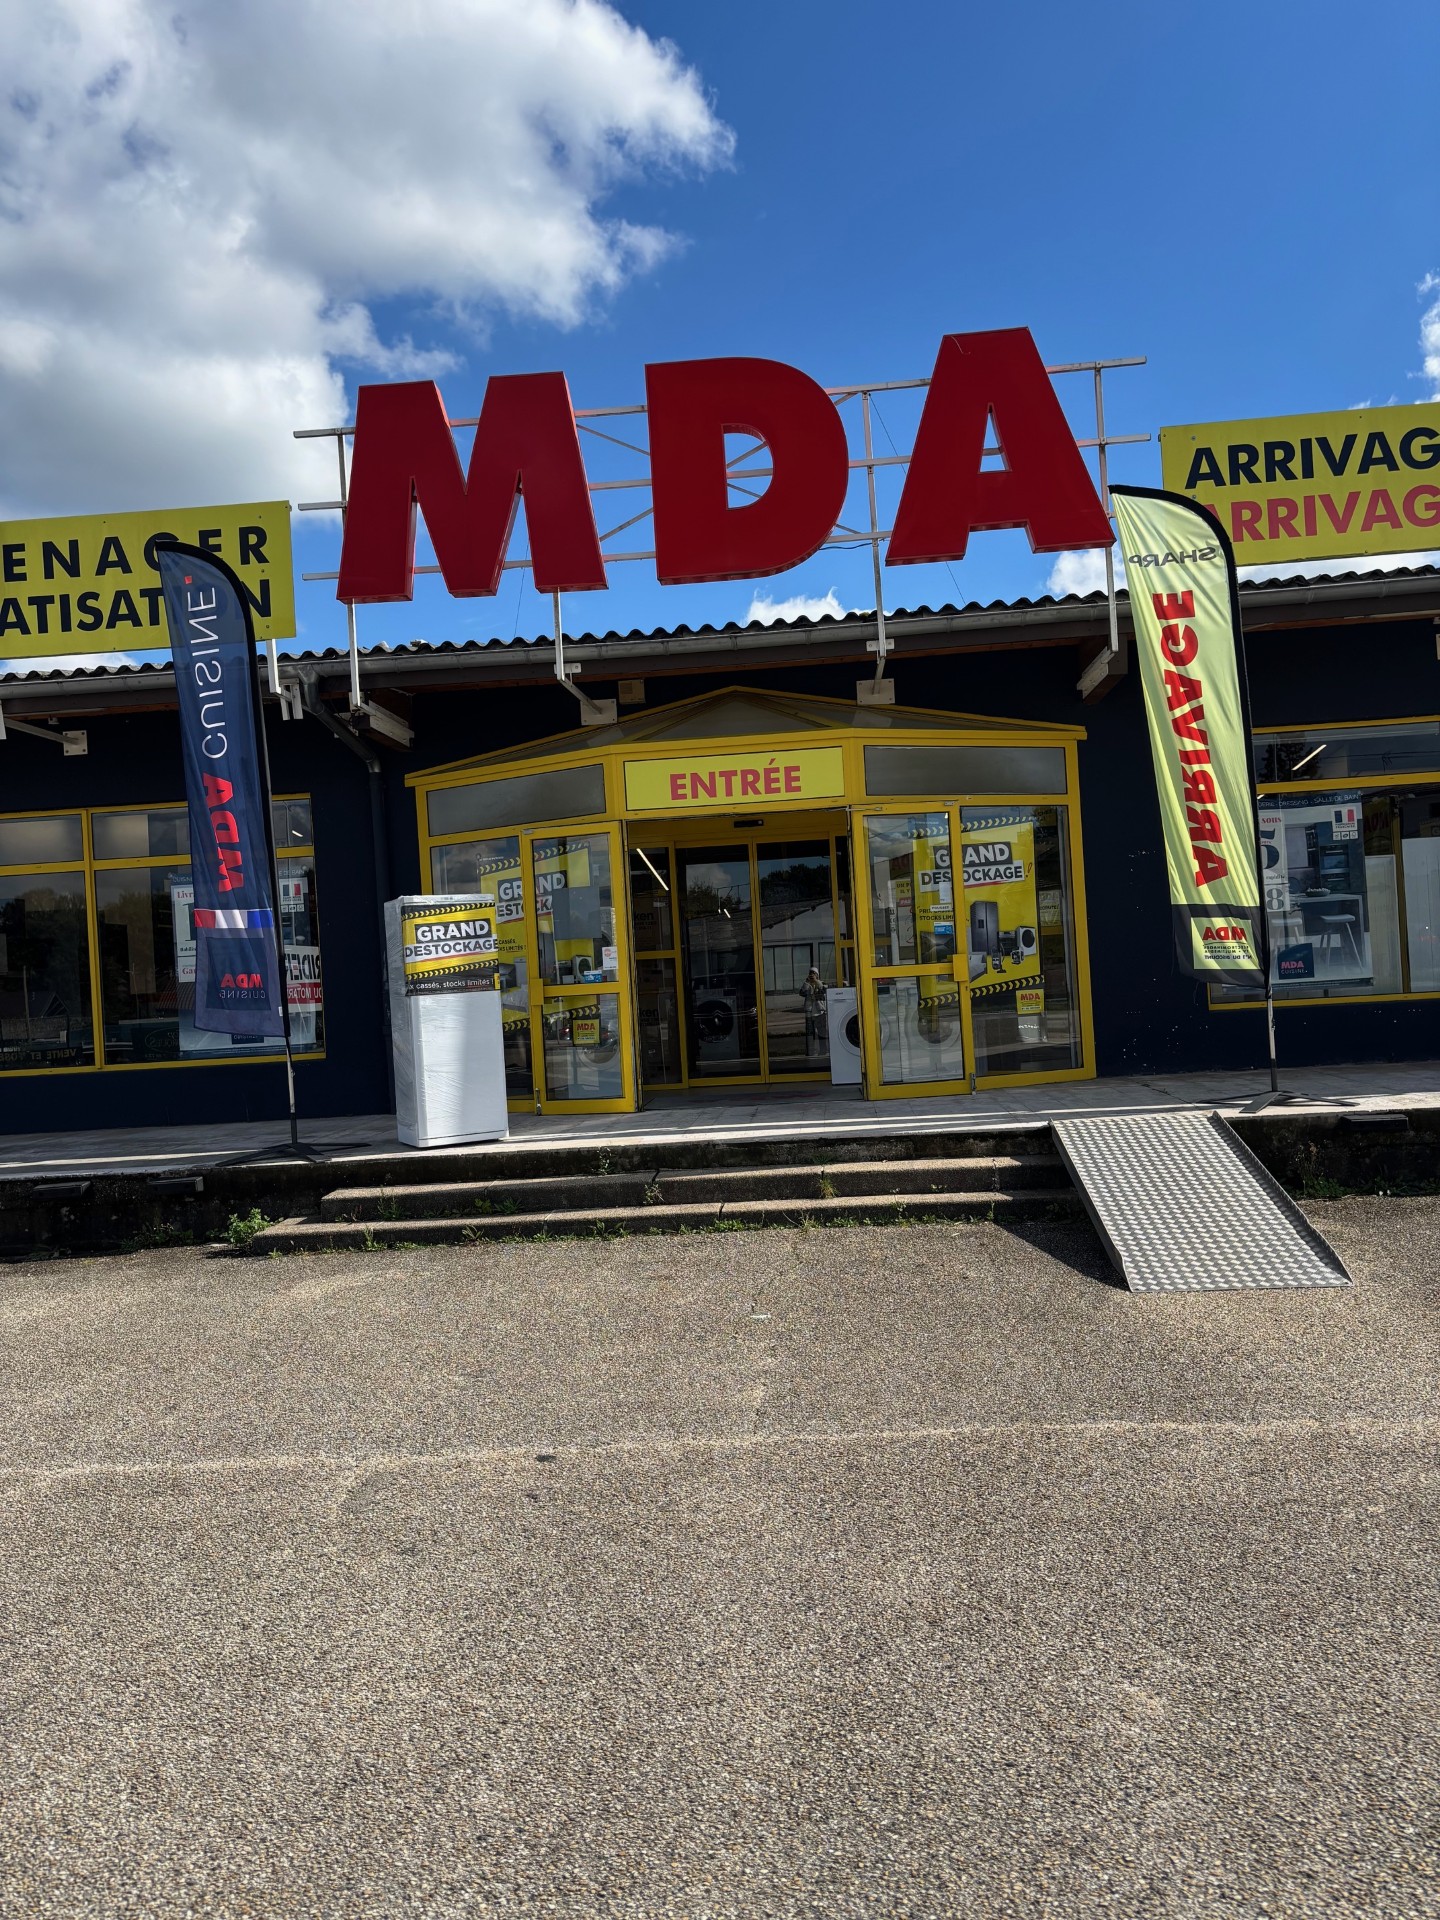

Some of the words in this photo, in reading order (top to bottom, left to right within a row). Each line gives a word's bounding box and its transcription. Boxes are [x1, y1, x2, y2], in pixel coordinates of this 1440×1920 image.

[338, 327, 1116, 603] MDA
[1185, 427, 1440, 489] ARRIVAG
[0, 578, 272, 637] ATISATN
[669, 758, 802, 801] ENTRÉE
[935, 844, 1010, 867] GAND
[922, 865, 1023, 885] DESOCKAGE
[499, 873, 565, 900] GRND
[1266, 887, 1284, 910] 8
[417, 920, 490, 942] GRAND
[405, 939, 499, 957] DESTOCKAGE
[1281, 960, 1305, 969] MDA
[443, 979, 465, 987] stocks
[1020, 992, 1040, 1001] MDA
[576, 1022, 595, 1031] MDA
